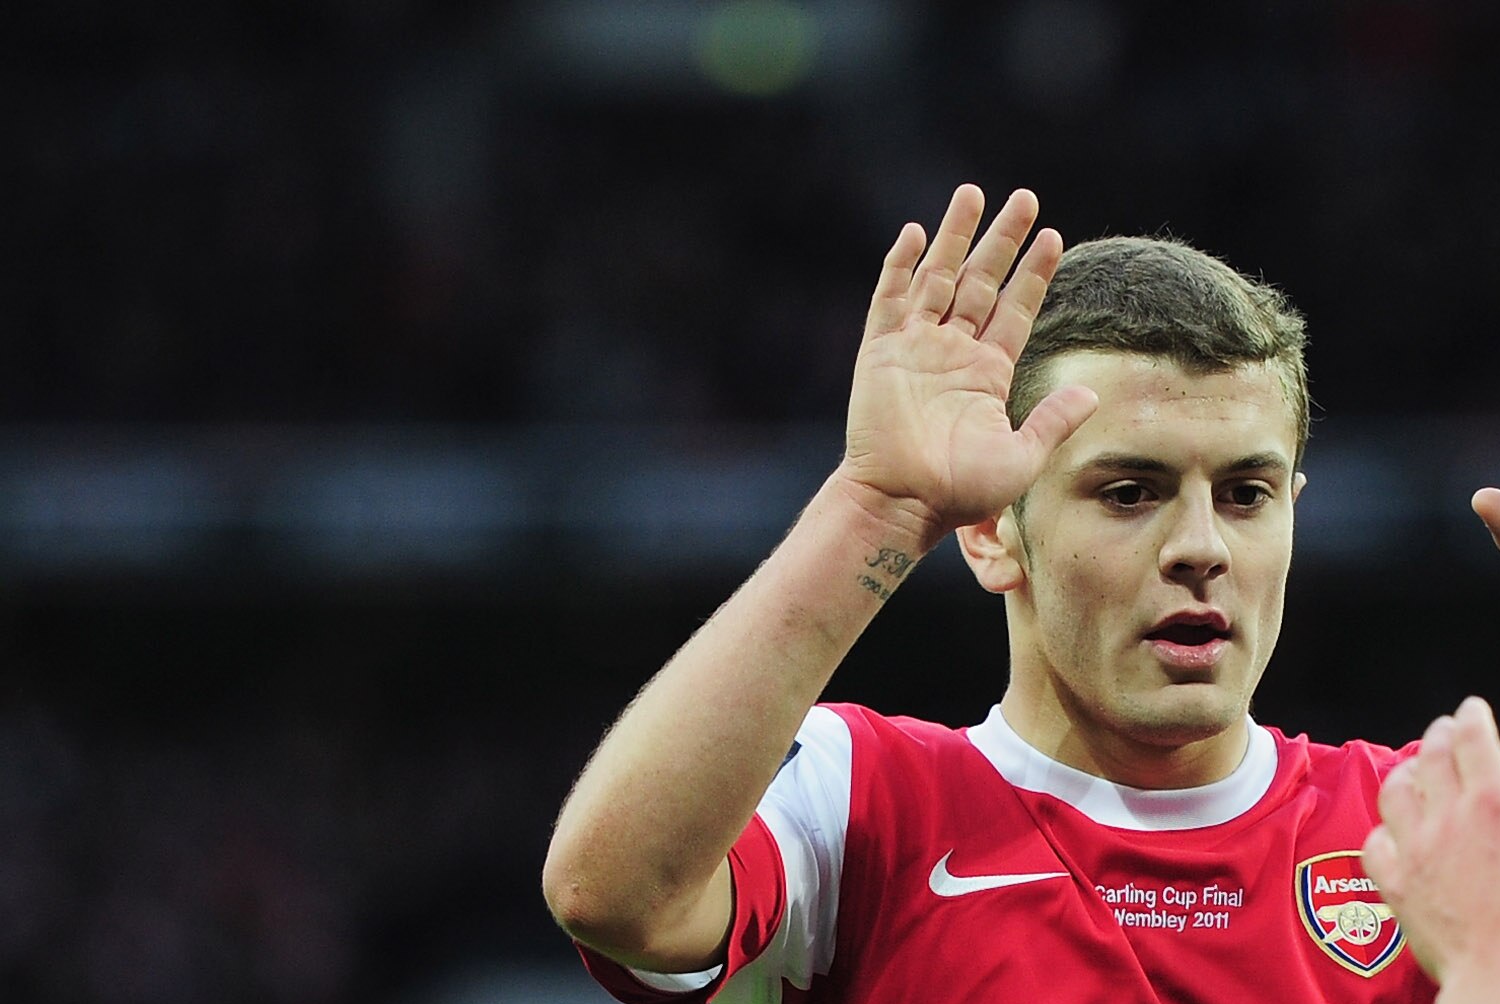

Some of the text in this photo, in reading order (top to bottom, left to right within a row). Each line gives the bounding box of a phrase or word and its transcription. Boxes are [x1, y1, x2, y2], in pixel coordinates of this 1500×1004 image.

[1314, 875, 1380, 894] Arsen
[1162, 886, 1198, 910] Cup
[1203, 883, 1244, 907] Final
[1192, 911, 1230, 929] 2011
